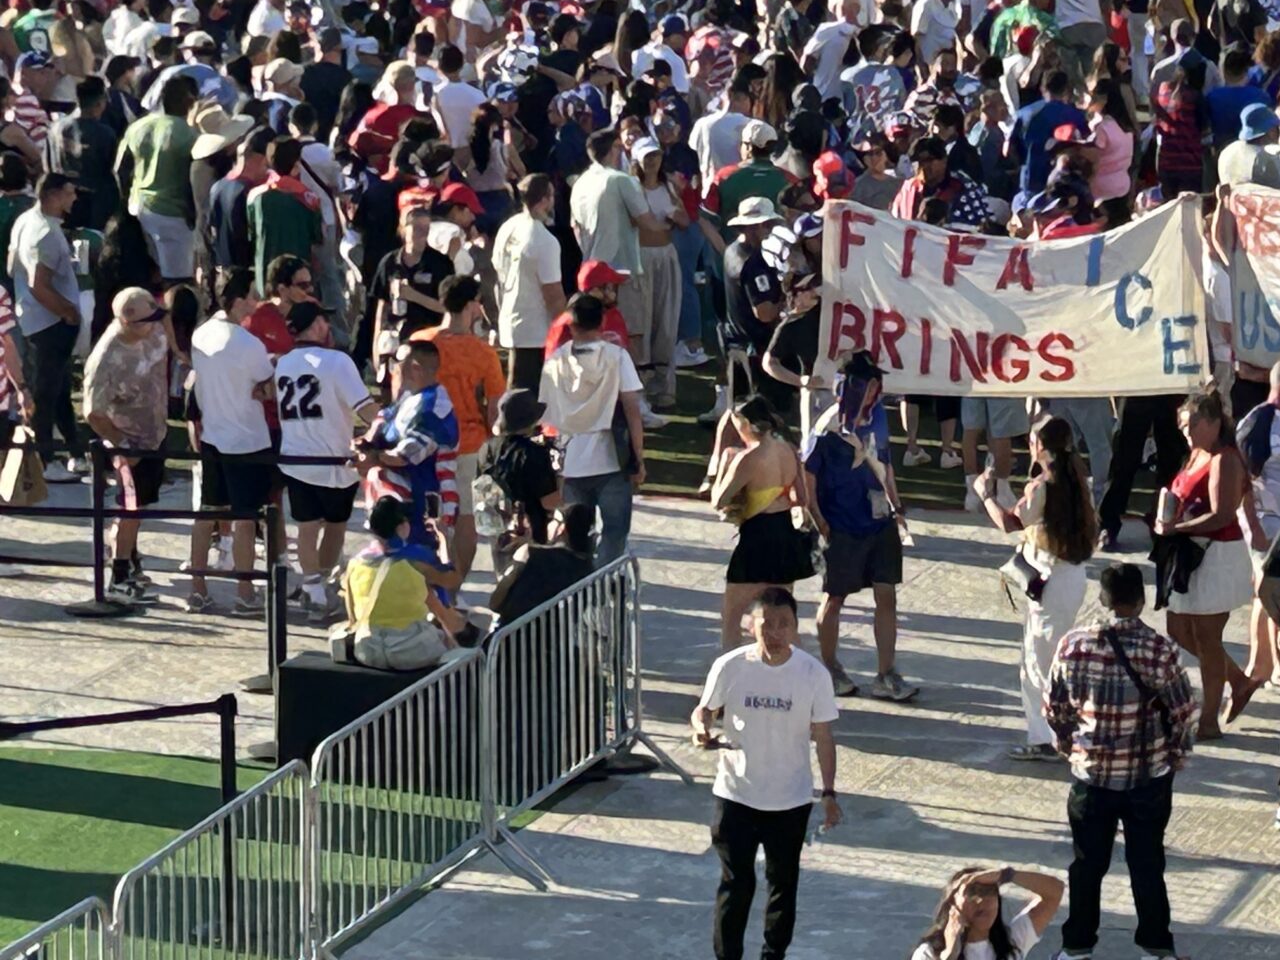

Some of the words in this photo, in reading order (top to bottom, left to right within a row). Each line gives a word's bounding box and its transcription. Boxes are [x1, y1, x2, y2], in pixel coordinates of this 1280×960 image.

[839, 210, 1035, 292] FIFA
[828, 301, 1076, 384] BRINGS
[277, 373, 324, 421] 22
